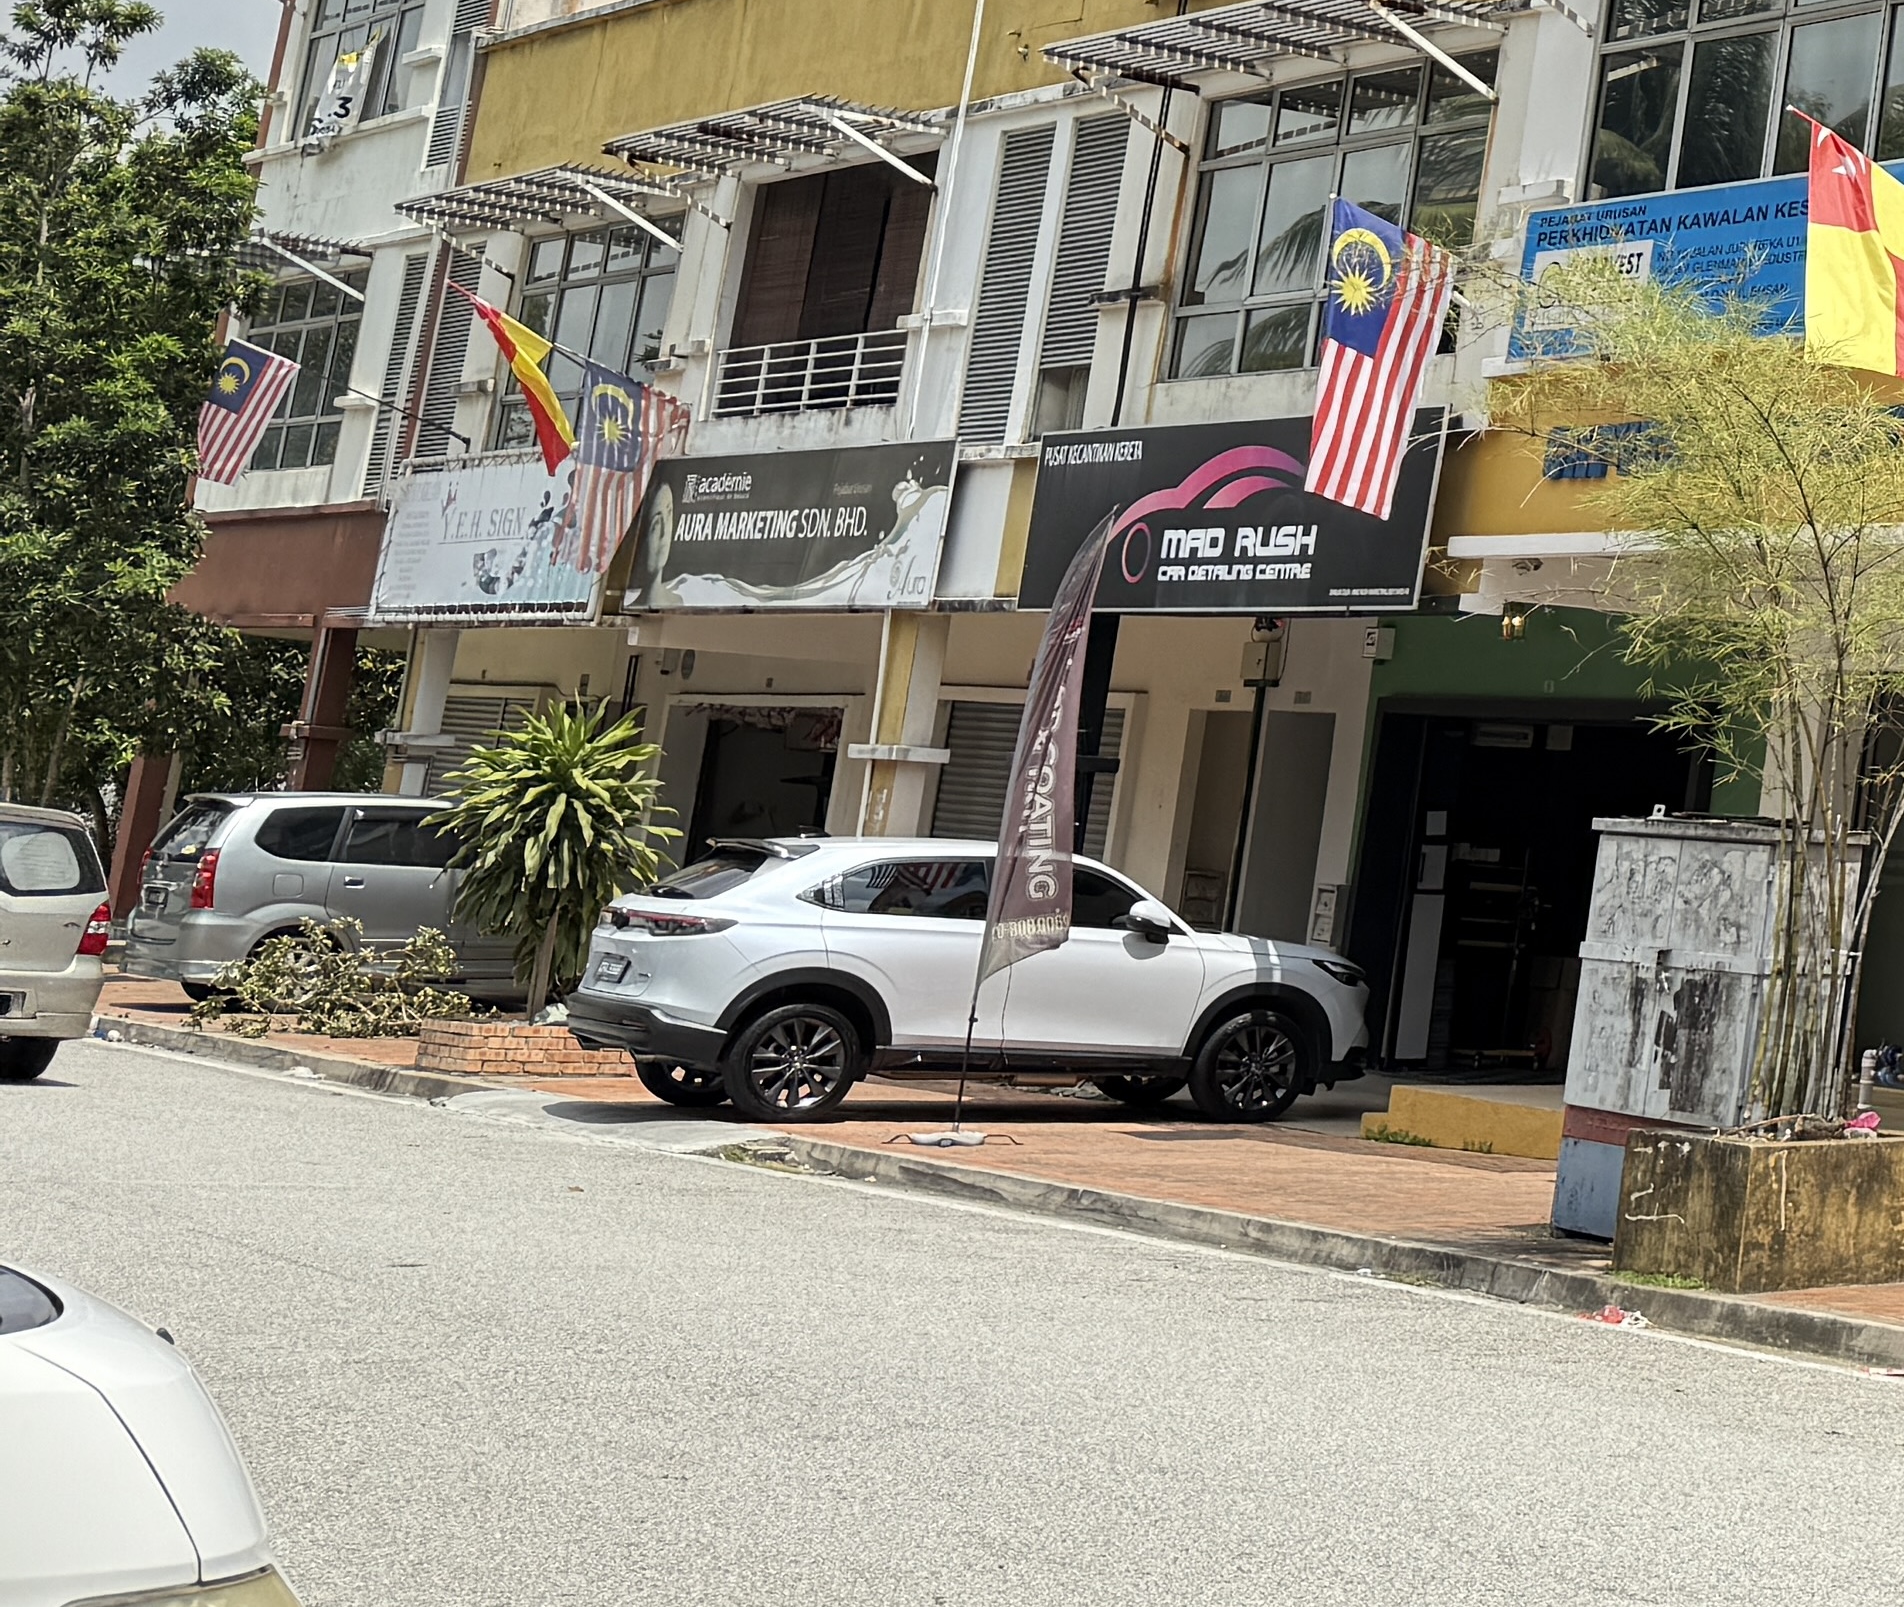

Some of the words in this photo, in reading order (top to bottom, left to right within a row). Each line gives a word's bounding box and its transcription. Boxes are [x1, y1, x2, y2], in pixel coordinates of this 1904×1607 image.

[1597, 205, 1647, 221] URUSAN
[1676, 204, 1769, 232] KAWALAN
[487, 507, 527, 537] SIGN
[674, 513, 712, 541] AURA
[714, 509, 799, 540] MARKETING
[798, 508, 831, 538] SDN.
[834, 506, 868, 537] BHD.
[1161, 527, 1225, 558] MAD
[1234, 525, 1318, 557] RUSH
[1158, 565, 1185, 581] CAR
[1187, 563, 1253, 581] DETAILING
[1255, 563, 1312, 580] CENTRE
